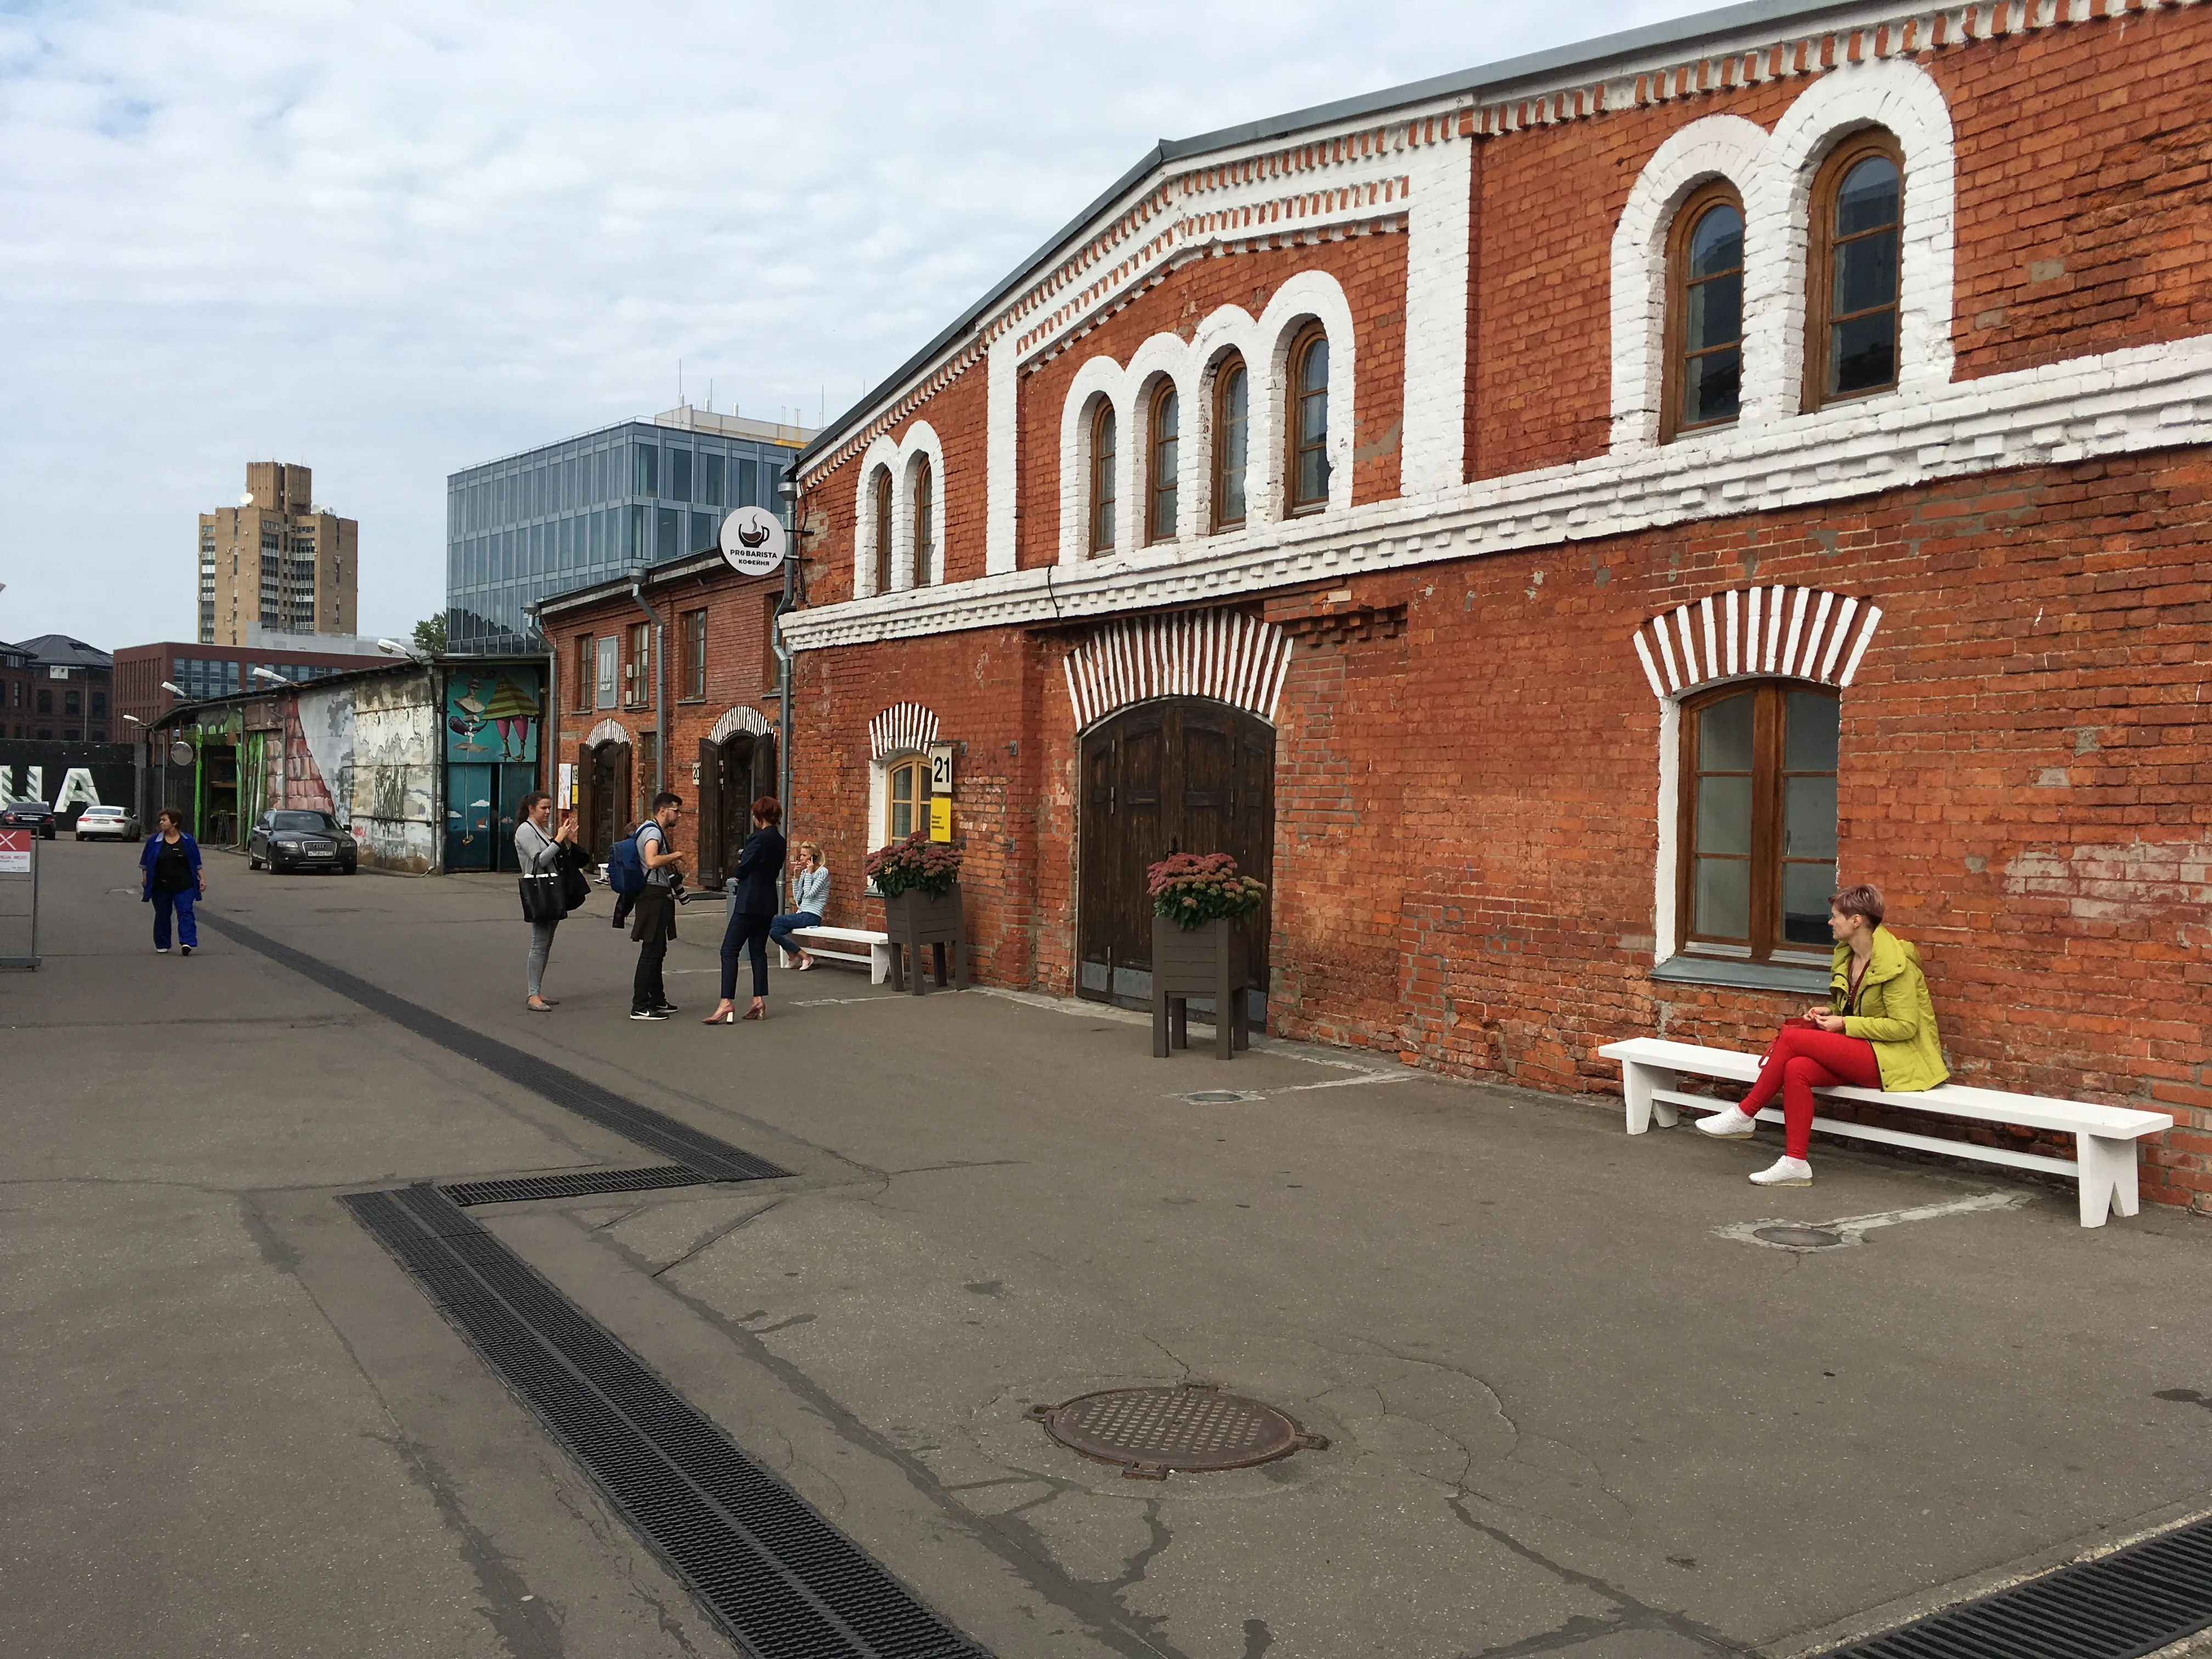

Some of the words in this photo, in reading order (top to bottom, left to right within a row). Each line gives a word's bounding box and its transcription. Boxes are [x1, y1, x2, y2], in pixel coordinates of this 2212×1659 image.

[572, 769, 578, 781] 19
[693, 766, 699, 780] 20
[934, 756, 950, 783] 21
